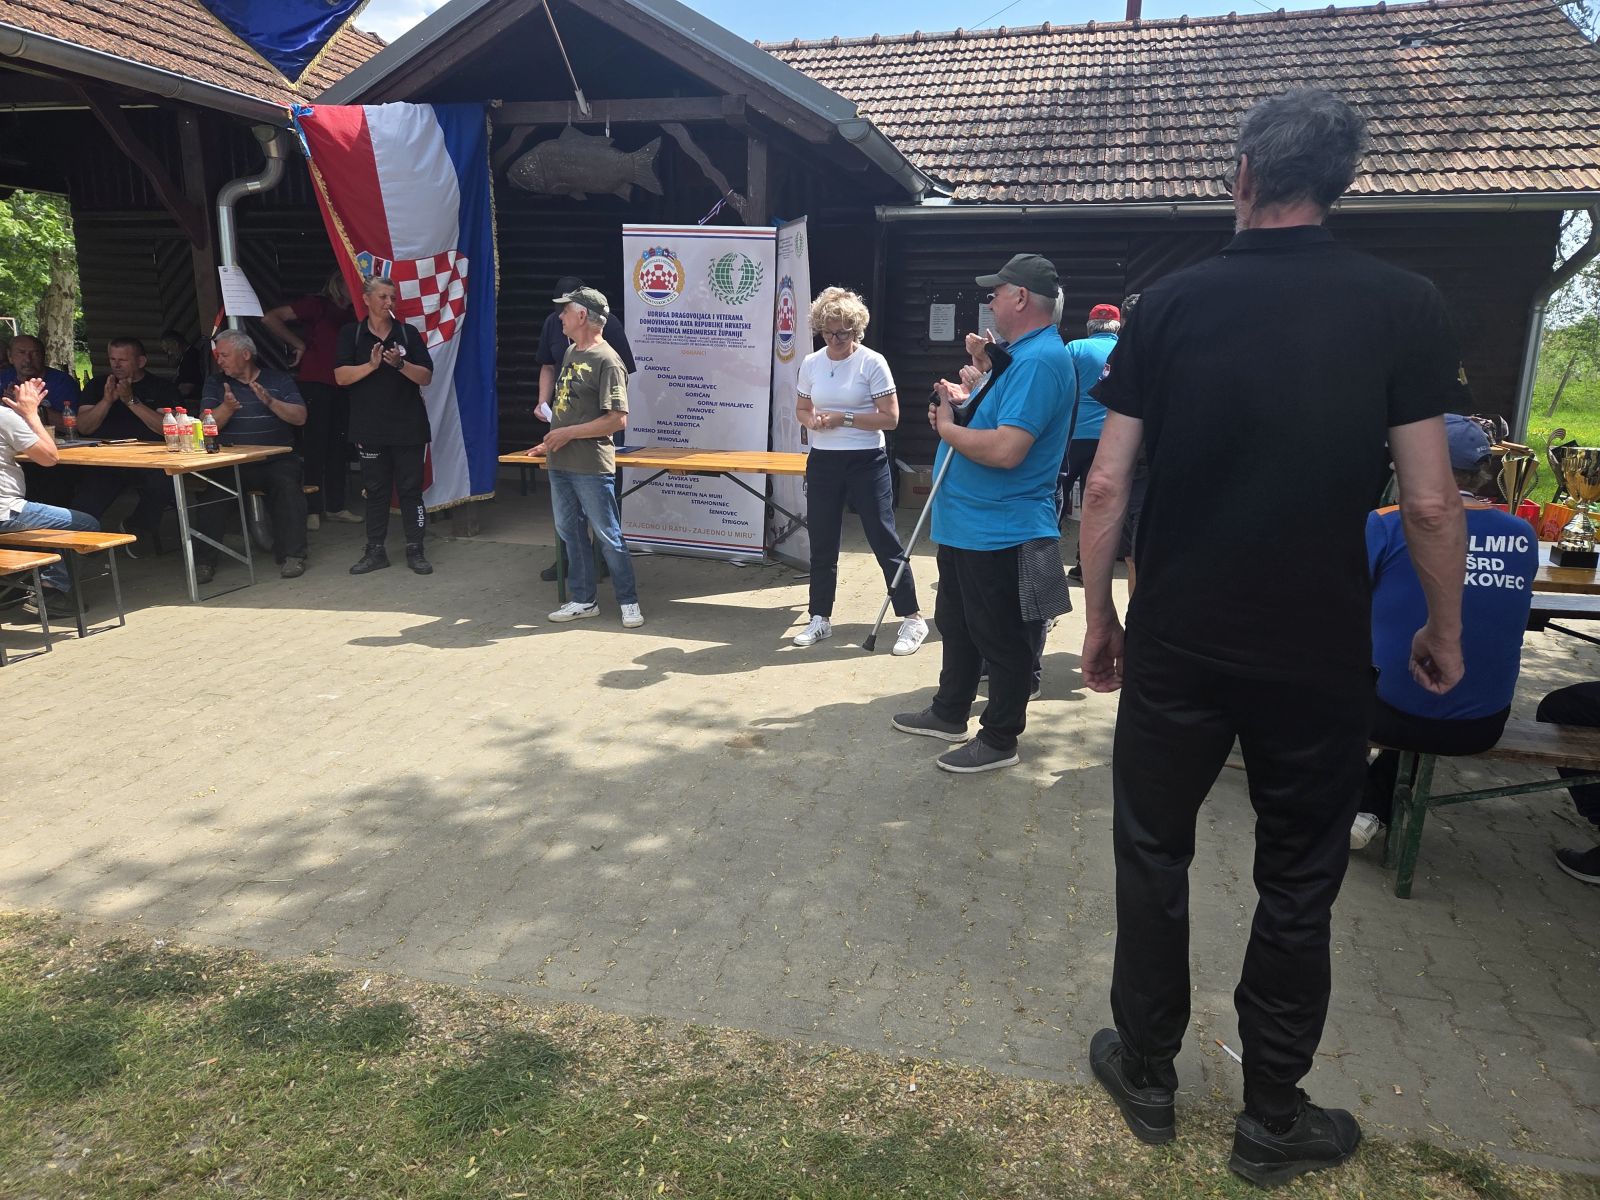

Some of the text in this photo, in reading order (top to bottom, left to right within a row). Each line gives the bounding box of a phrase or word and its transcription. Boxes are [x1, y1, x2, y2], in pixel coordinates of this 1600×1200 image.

[639, 318, 679, 327] DOMOVINSKOG
[694, 320, 723, 328] REPUBLIKE
[724, 322, 752, 330] HRVATSKE
[719, 401, 754, 409] MIHALJEVEC
[668, 525, 687, 533] RATU
[692, 528, 726, 537] ZAJEDNO
[1467, 535, 1529, 553] LMIC
[1465, 553, 1505, 571] ŠRD
[1463, 571, 1525, 590] KOVEC
